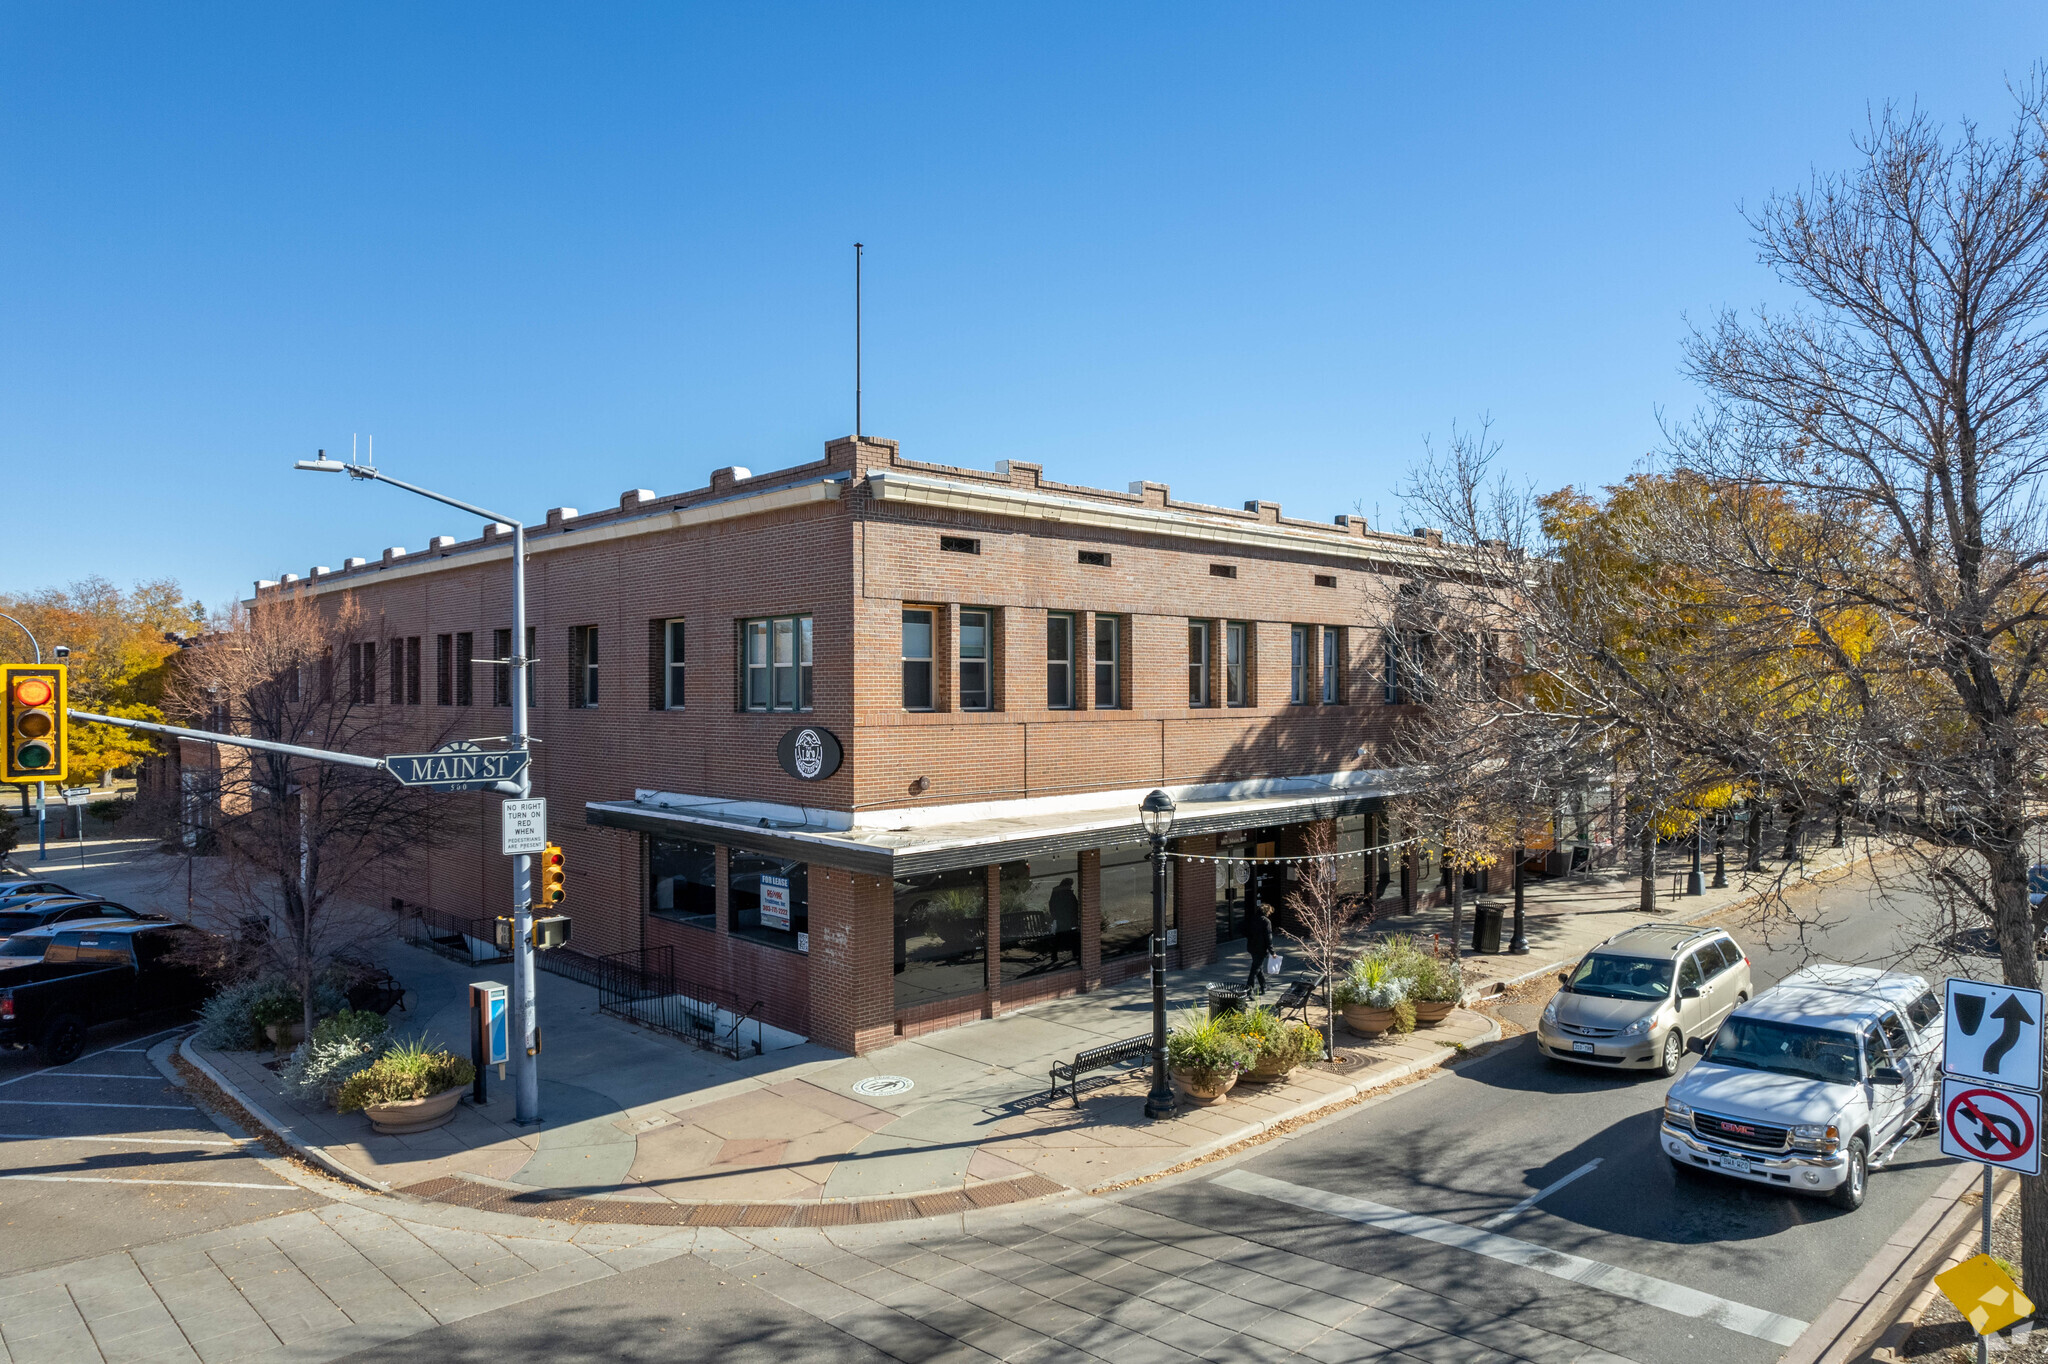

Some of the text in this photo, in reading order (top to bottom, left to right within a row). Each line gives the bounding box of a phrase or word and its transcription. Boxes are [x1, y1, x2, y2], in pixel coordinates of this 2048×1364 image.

[411, 755, 509, 781] MAIN ST
[762, 875, 788, 887] FOR LEASE
[1721, 1121, 1755, 1136] GMC
